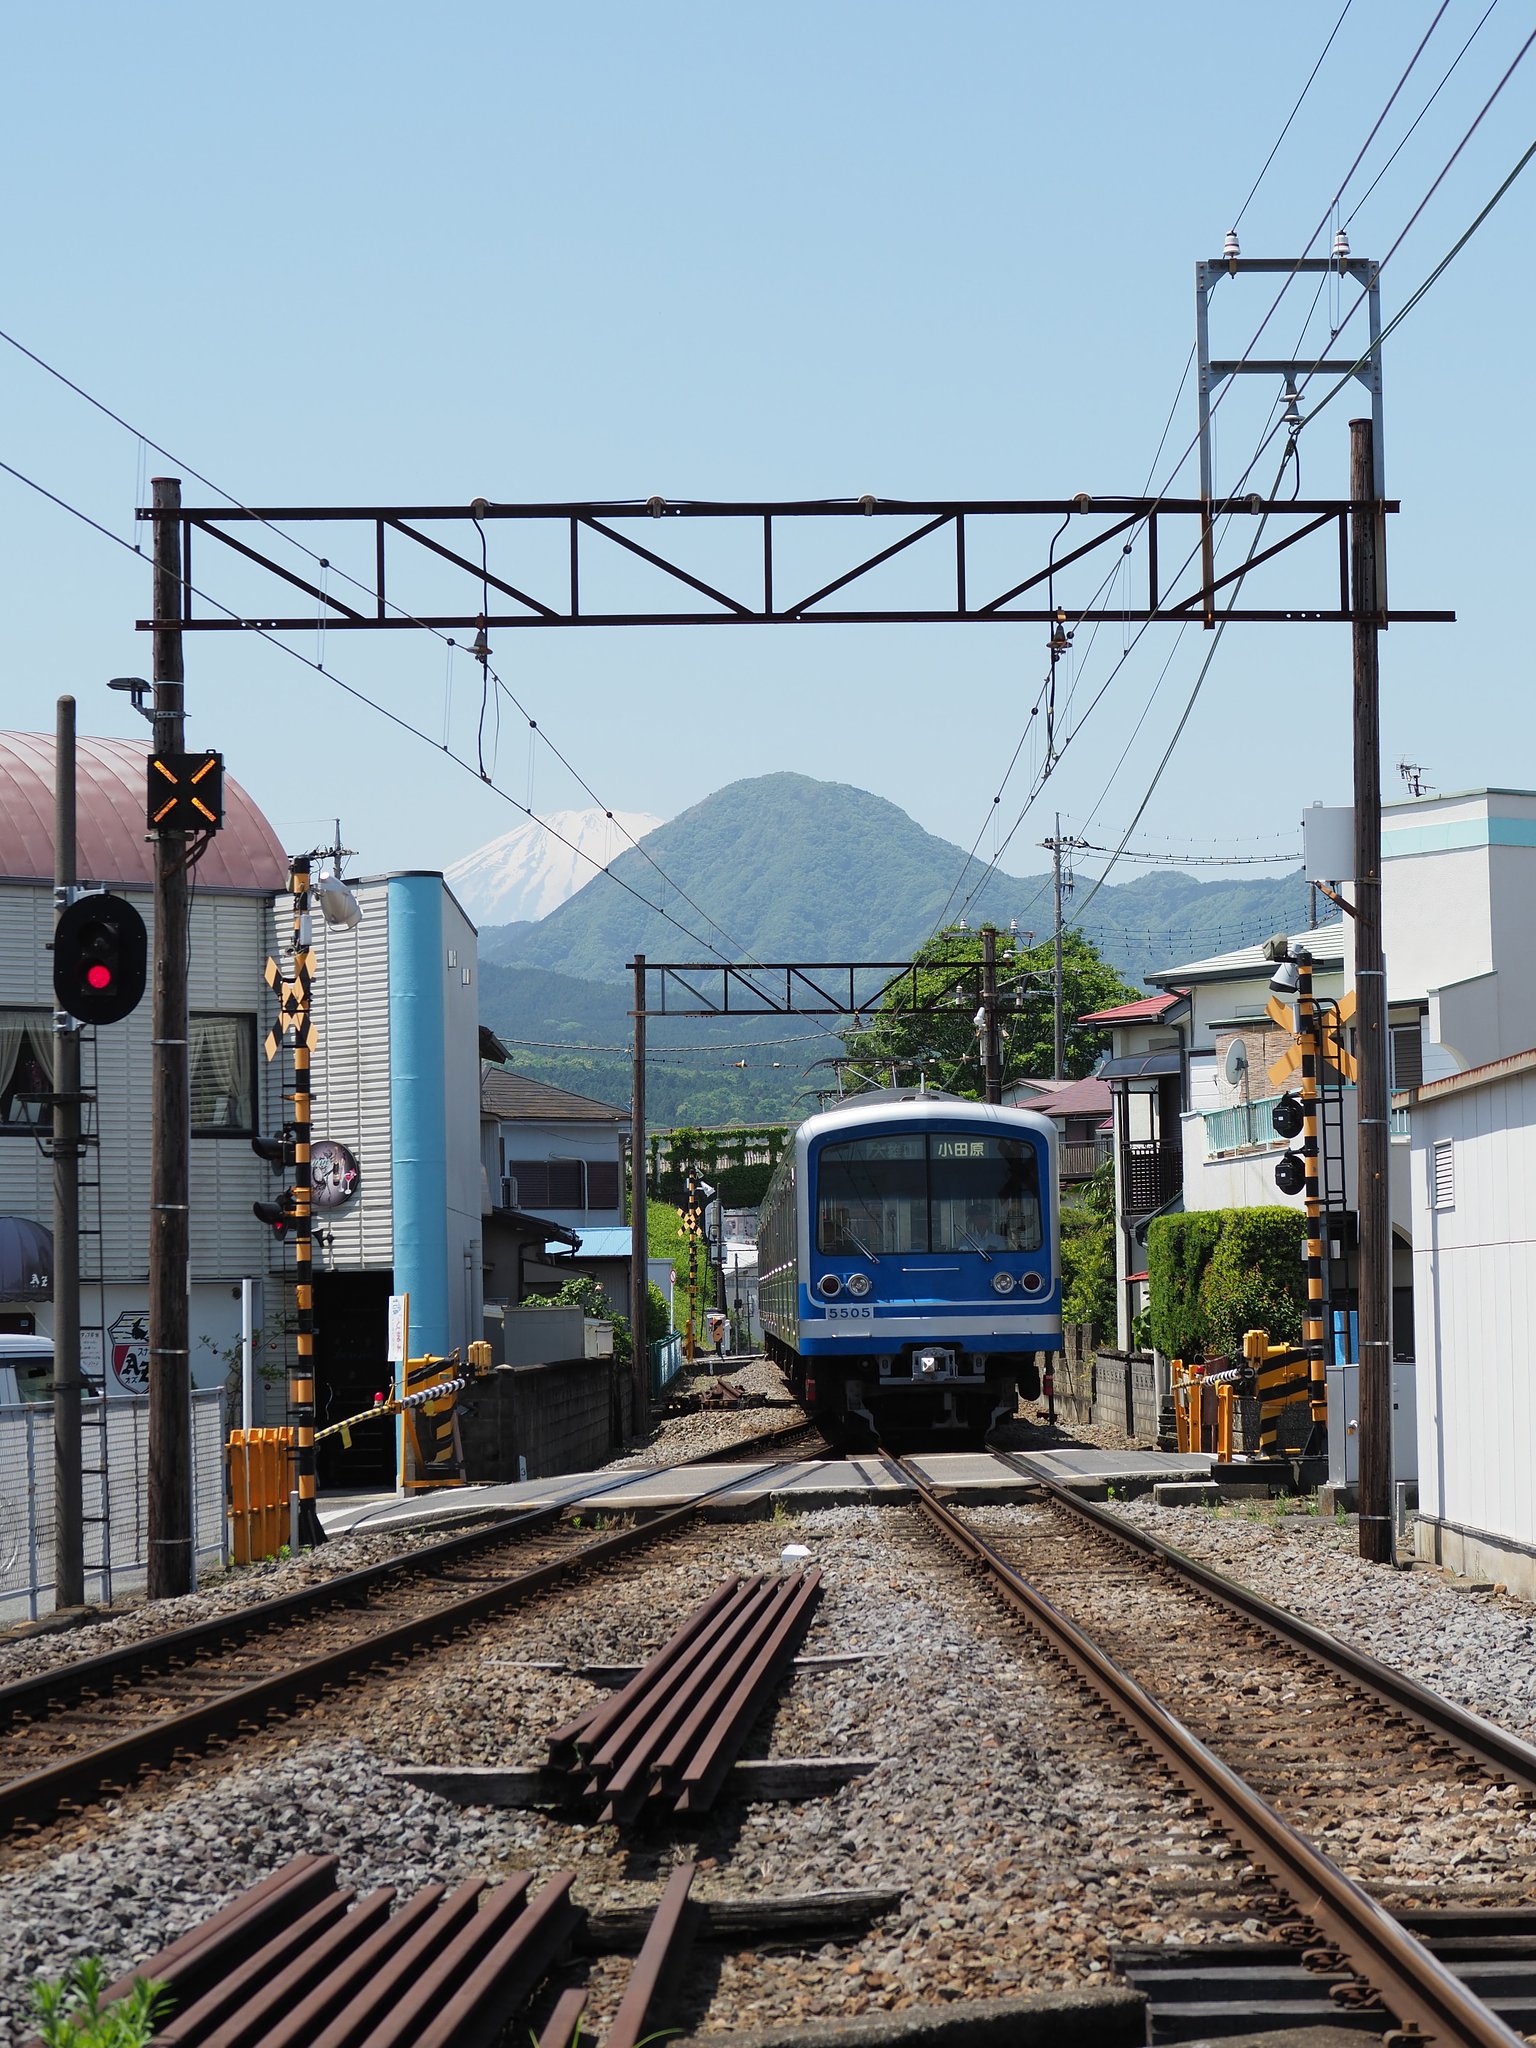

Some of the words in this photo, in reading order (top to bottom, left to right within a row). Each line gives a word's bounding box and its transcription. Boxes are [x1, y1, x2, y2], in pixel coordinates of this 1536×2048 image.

[938, 1142, 984, 1157] 小田原
[829, 1307, 870, 1319] 5505
